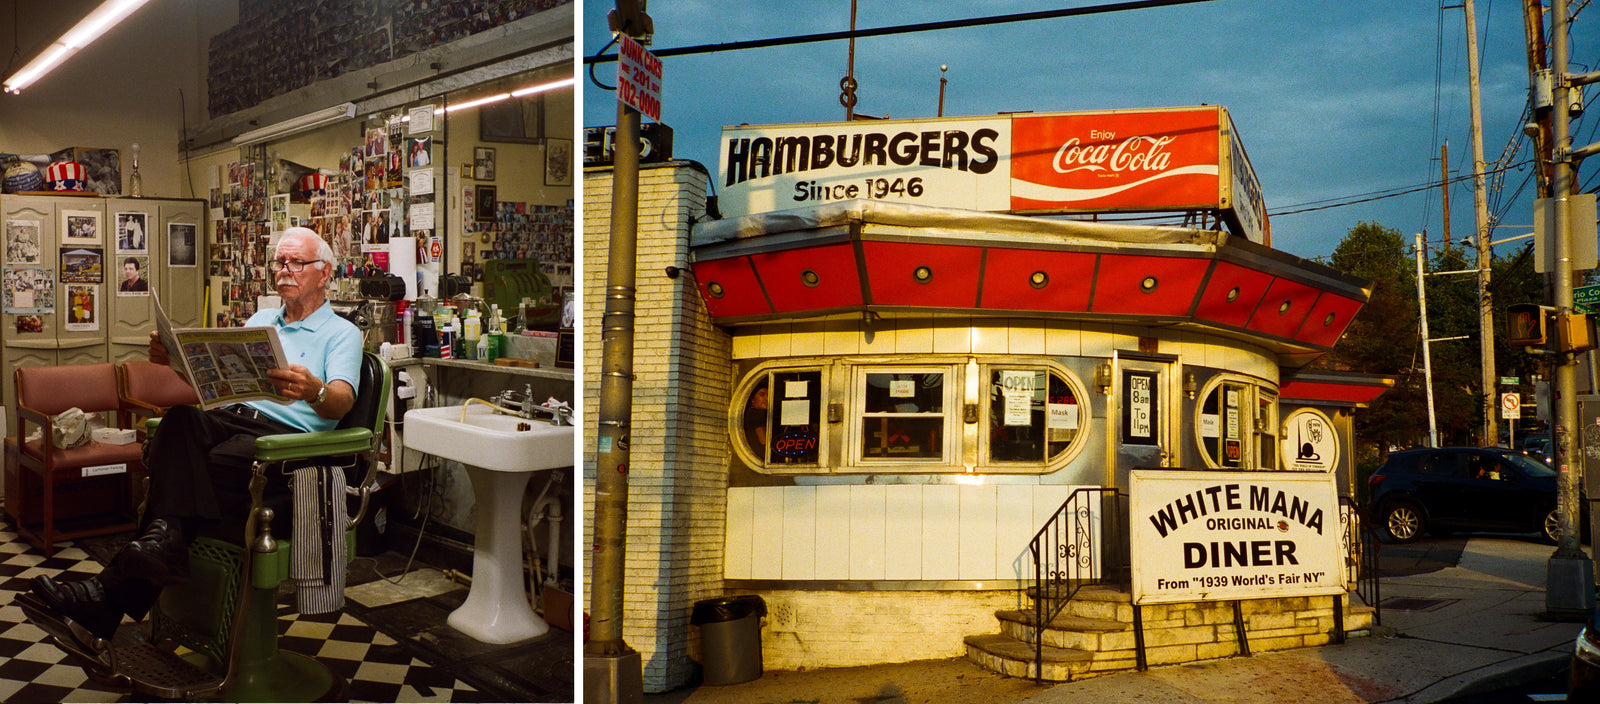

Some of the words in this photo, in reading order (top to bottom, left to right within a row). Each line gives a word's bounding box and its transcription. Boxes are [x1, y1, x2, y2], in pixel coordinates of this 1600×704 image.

[621, 36, 643, 66] JUNK
[644, 53, 662, 80] CARS
[633, 66, 650, 90] 201
[619, 76, 660, 120] 702-0000
[1090, 130, 1116, 140] Enjoy
[725, 128, 999, 188] HAMBURGERS
[1052, 135, 1177, 174] Coca-Cola
[793, 180, 860, 201] Since
[865, 177, 924, 199] 1946
[1004, 375, 1035, 392] OPEN
[1132, 378, 1150, 391] OPEN
[776, 439, 816, 450] OPEN
[1149, 484, 1242, 539] WHITE
[1250, 485, 1324, 536] MANA
[1206, 517, 1274, 531] ORIGINAL
[1183, 540, 1299, 569] DINER
[1157, 578, 1189, 590] From
[1193, 576, 1228, 588] "1939
[1232, 574, 1275, 586] World's
[1278, 573, 1300, 584] Fair
[1304, 572, 1325, 582] NY"
